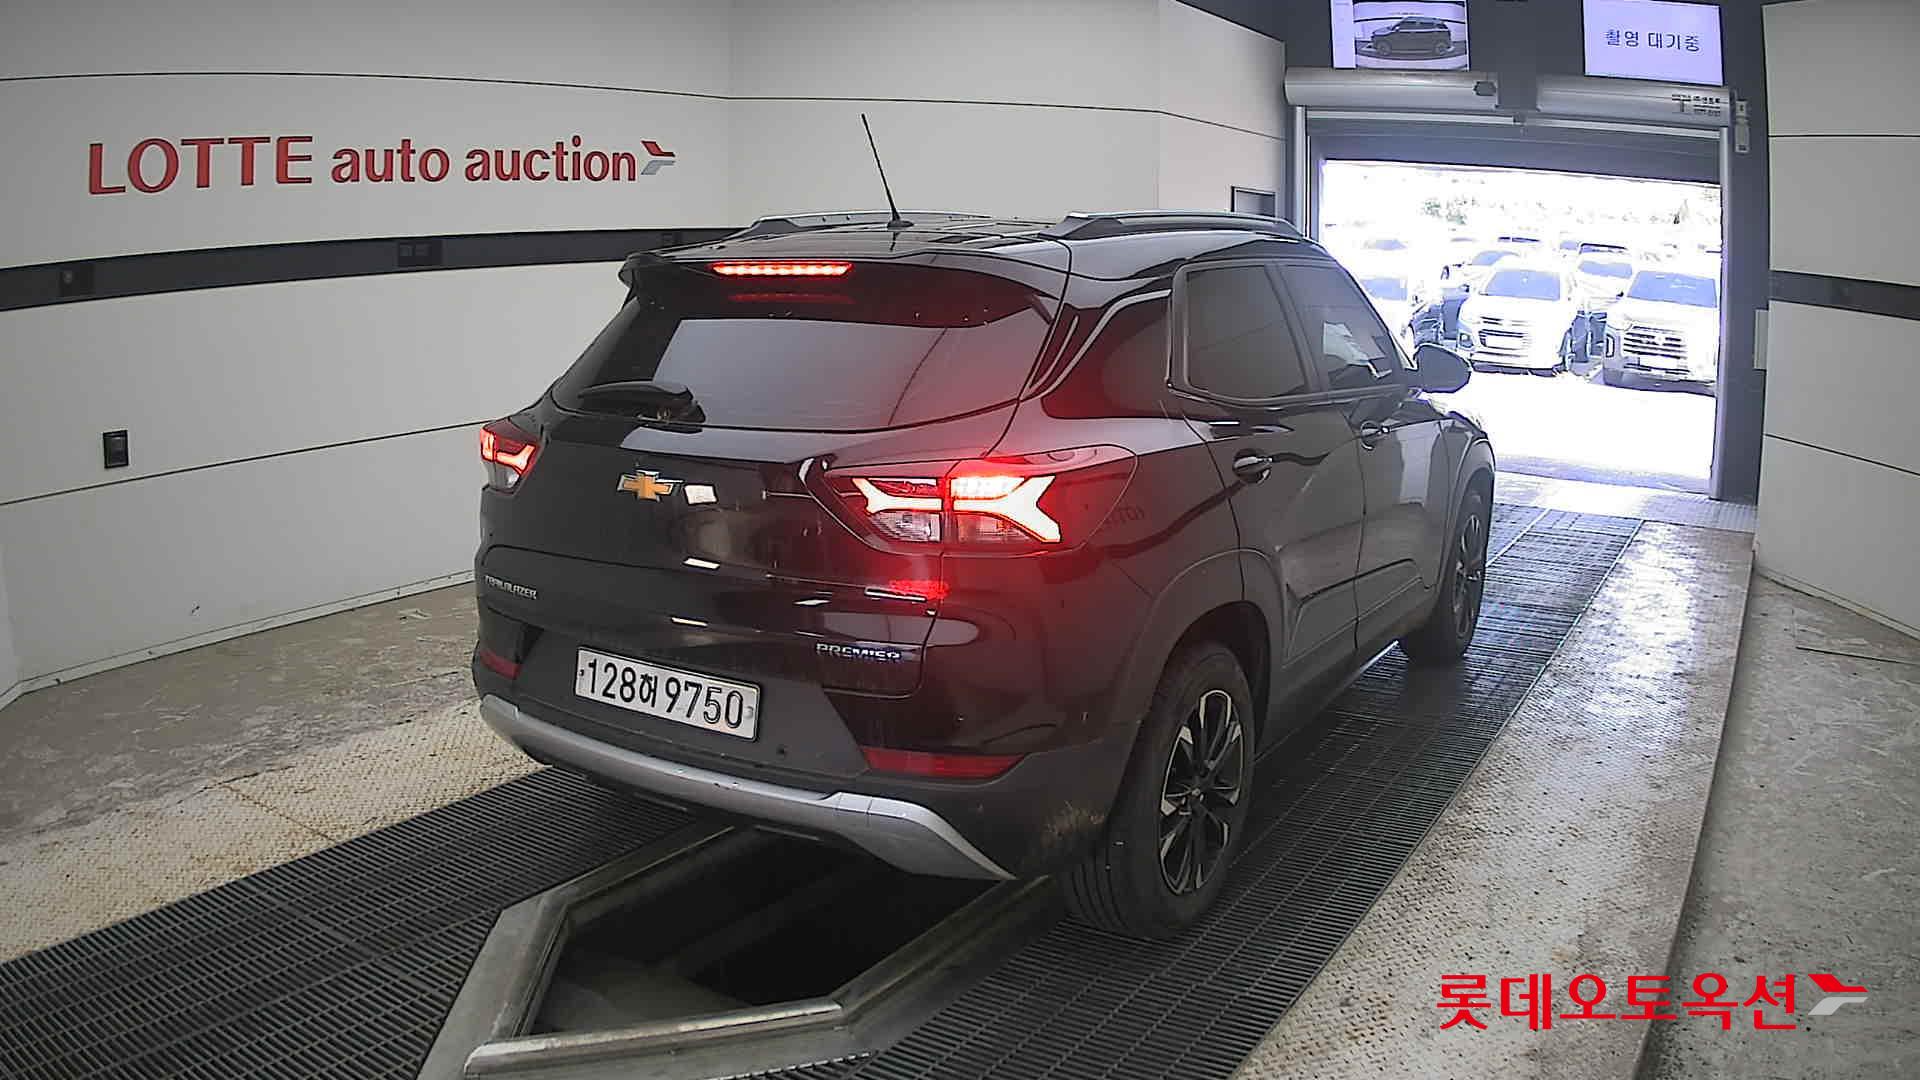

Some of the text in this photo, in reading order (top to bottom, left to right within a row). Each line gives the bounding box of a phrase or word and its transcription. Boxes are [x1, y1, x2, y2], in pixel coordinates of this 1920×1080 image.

[1647, 32, 1700, 52] 대기중
[88, 135, 637, 196] LOTTE auto auction
[816, 642, 902, 663] PREMIER
